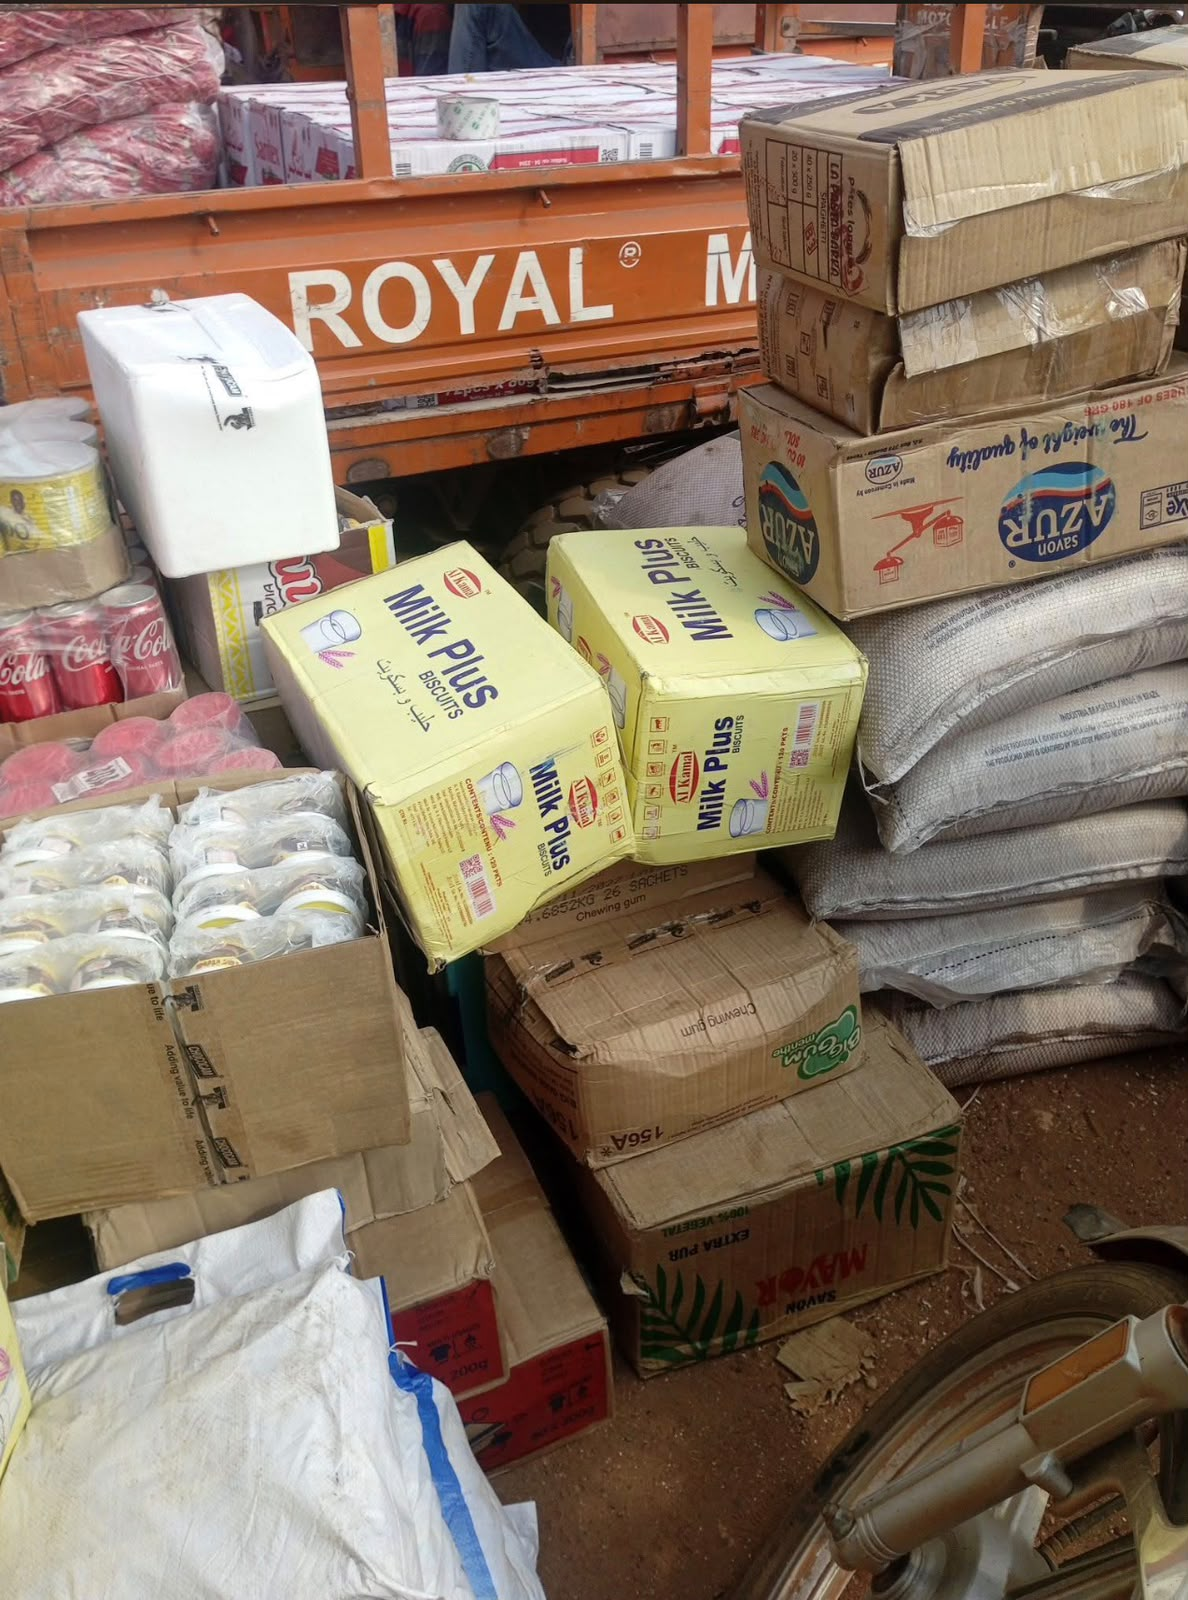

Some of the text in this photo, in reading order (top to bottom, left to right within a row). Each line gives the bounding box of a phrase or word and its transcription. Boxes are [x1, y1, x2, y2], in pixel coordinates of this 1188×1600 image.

[819, 191, 827, 244] SPAGHETTI
[288, 247, 615, 352] ROYAL
[1112, 398, 1133, 411] 180
[1136, 394, 1152, 405] OF
[946, 415, 1148, 472] The weight of quality
[868, 461, 902, 477] AZUR
[855, 476, 915, 497] Made in Cameroon by
[1004, 481, 1112, 548] AZUR
[760, 503, 815, 565] AZUR
[1038, 535, 1079, 556] savon
[664, 537, 700, 570] BISCUITS
[453, 576, 480, 598] Kamal
[634, 538, 734, 642] Milk Plus
[635, 614, 660, 636] Kamal
[383, 584, 451, 646] Milk
[428, 638, 499, 709] Plus
[418, 670, 465, 721] BISCUITS
[731, 714, 745, 754] BISCUITS
[780, 727, 789, 747] PKTS
[677, 750, 695, 787] Kamal
[696, 715, 734, 831] Milk Plus
[573, 778, 586, 792] Al
[677, 787, 695, 804] Al
[529, 757, 571, 871] Milk Plus
[488, 856, 498, 869] 120
[537, 842, 552, 877] BISCUITS
[492, 868, 504, 887] PKTS
[605, 886, 623, 900] 26
[628, 865, 689, 894] SACHETS
[577, 895, 647, 922] Chewing gum
[150, 995, 160, 1007] to
[153, 1006, 164, 1022] life
[680, 1002, 756, 1038] Chewing gum
[772, 1032, 816, 1058] menthe
[782, 1036, 837, 1066] GUM
[830, 1026, 860, 1058] BIG
[186, 1044, 218, 1079] CHOCOCAM
[164, 1044, 180, 1074] Adding
[174, 1075, 187, 1097] value
[184, 1107, 194, 1120] life
[193, 1139, 208, 1167] Adding
[213, 1136, 244, 1169] CHOCOCAM
[661, 1205, 749, 1237] 100% VEGETAL
[668, 1228, 749, 1262] EXTRA PUR
[755, 1243, 868, 1307] MAYOR
[784, 1290, 836, 1314] SAVON
[452, 1360, 488, 1381] 200g
